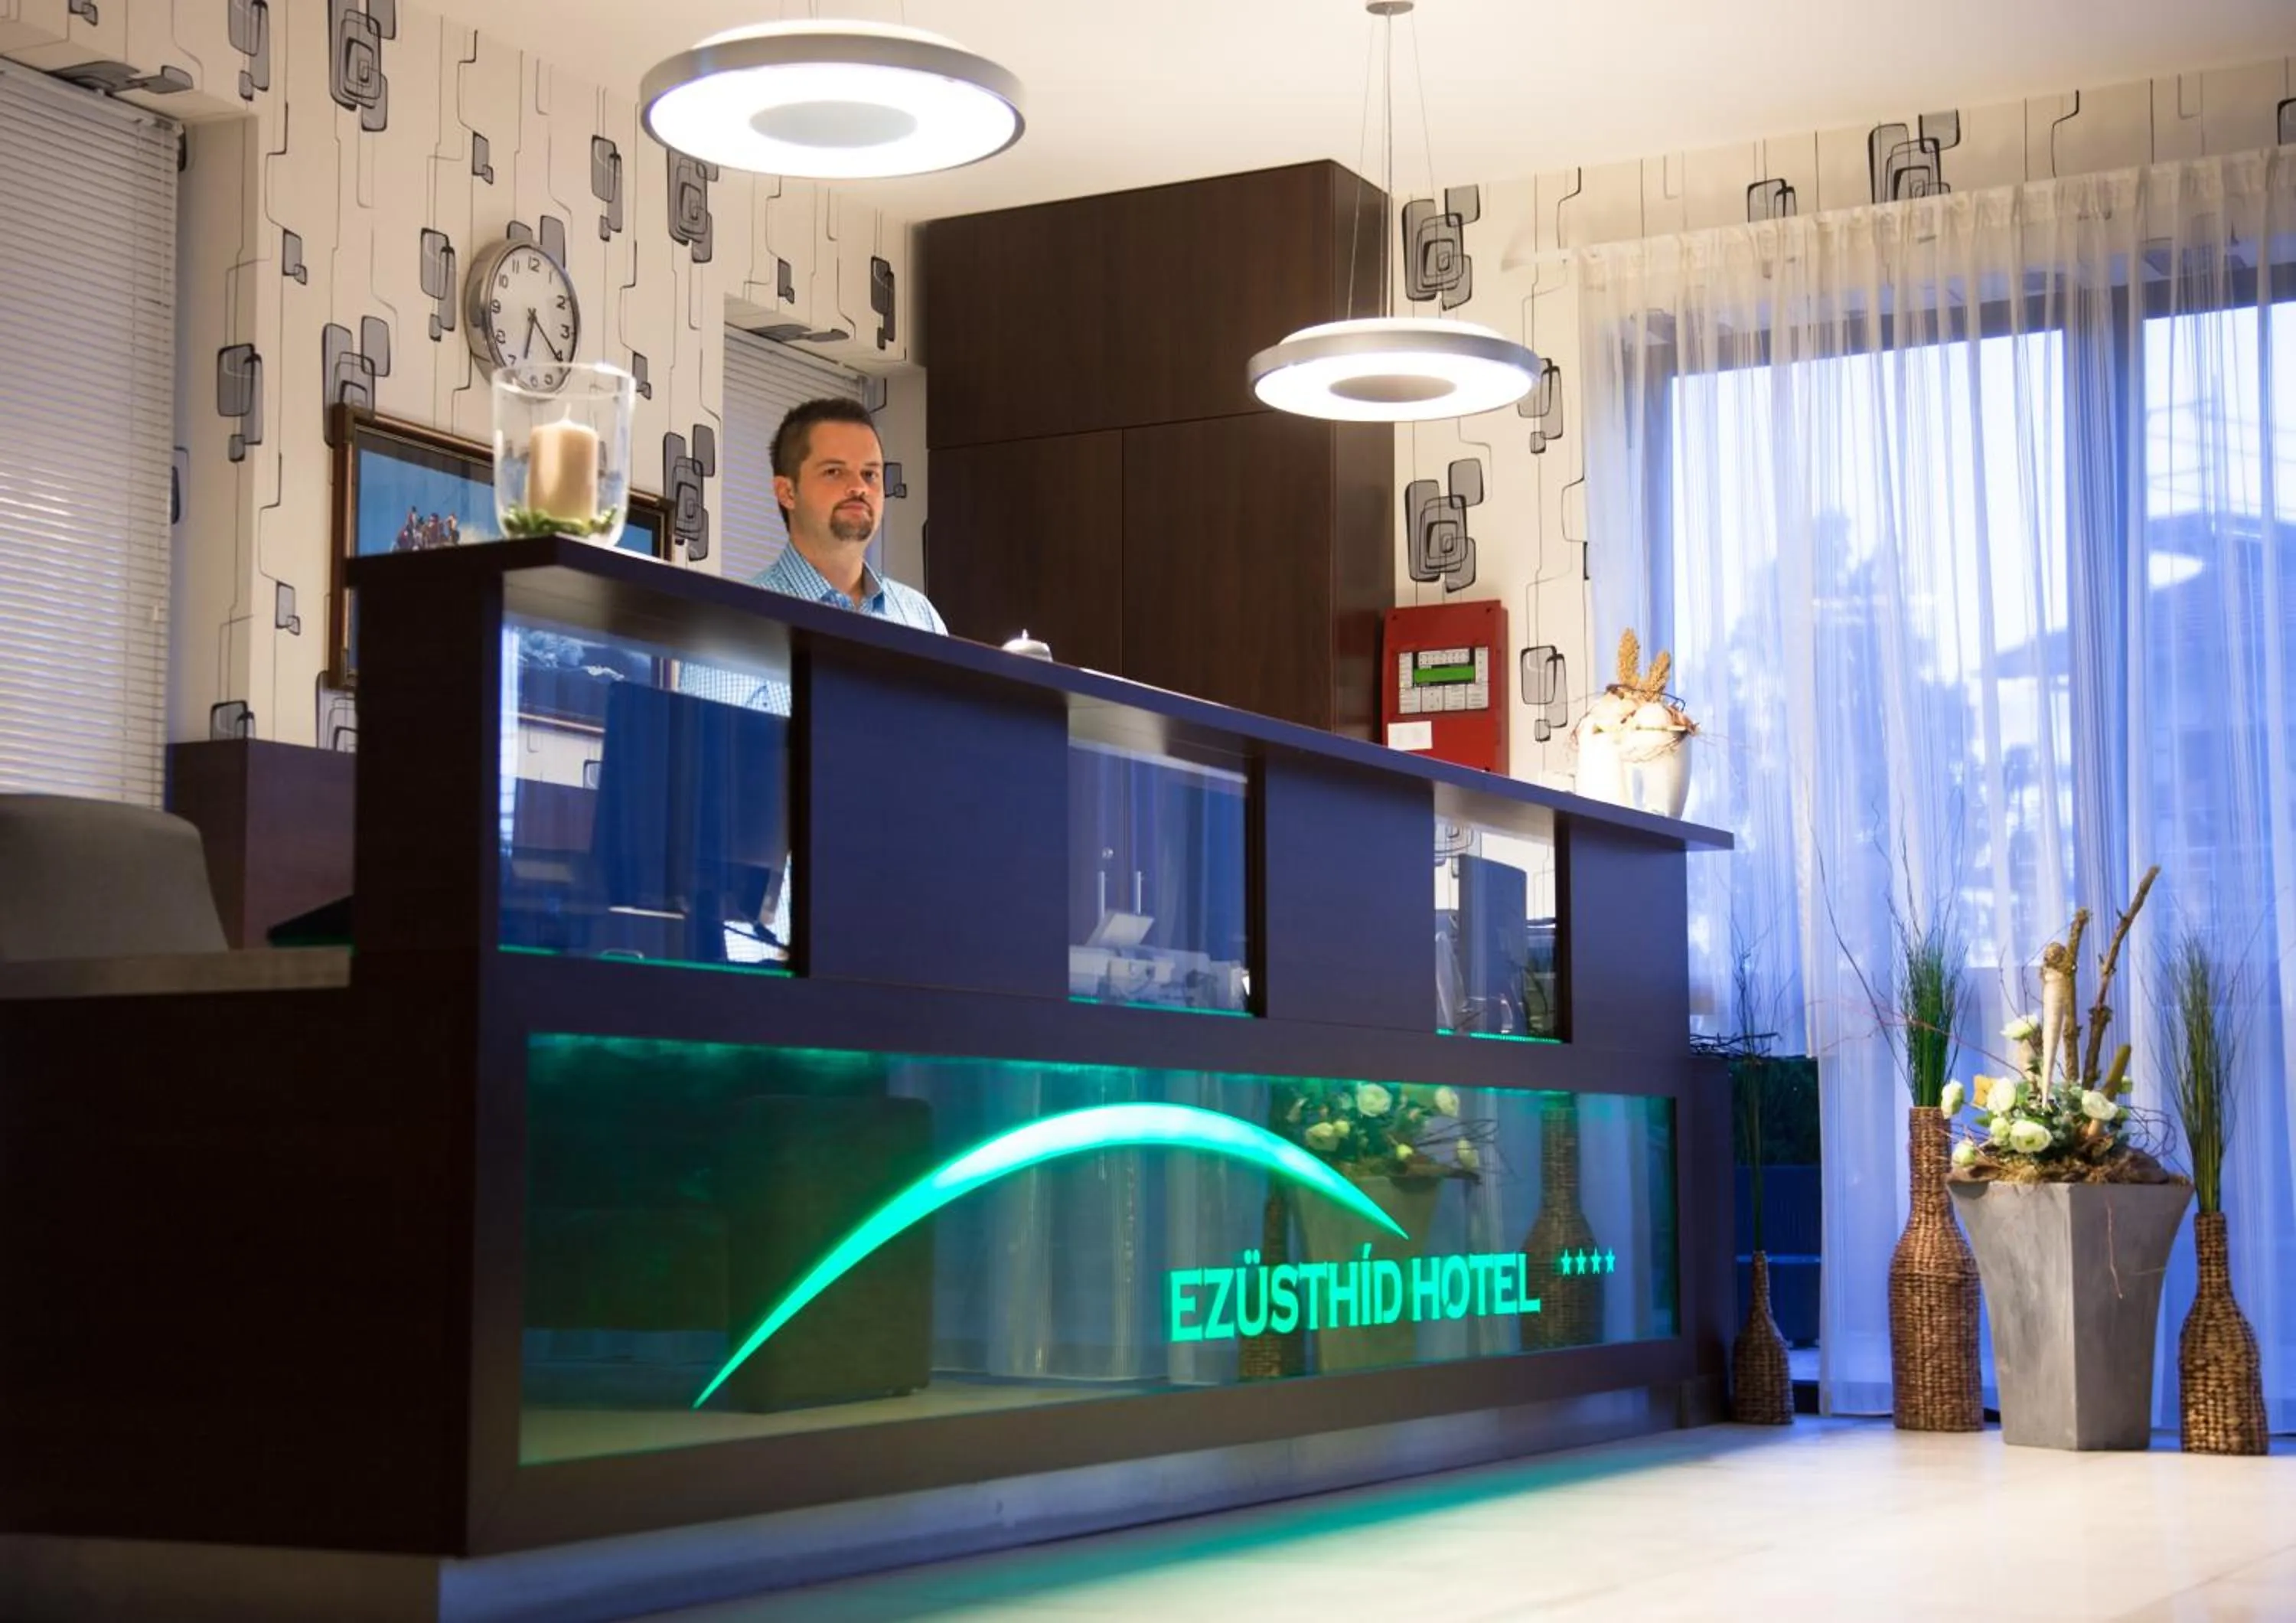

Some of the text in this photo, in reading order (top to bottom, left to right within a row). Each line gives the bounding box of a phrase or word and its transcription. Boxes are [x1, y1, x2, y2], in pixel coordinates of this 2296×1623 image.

[512, 259, 520, 274] 11
[527, 256, 540, 273] 12
[498, 274, 508, 289] 10
[491, 299, 501, 314] 9
[556, 295, 566, 310] 2
[561, 324, 570, 339] 3
[507, 354, 517, 364] 7
[1169, 1243, 1541, 1342] EZÜSTHÍD HOTEL
